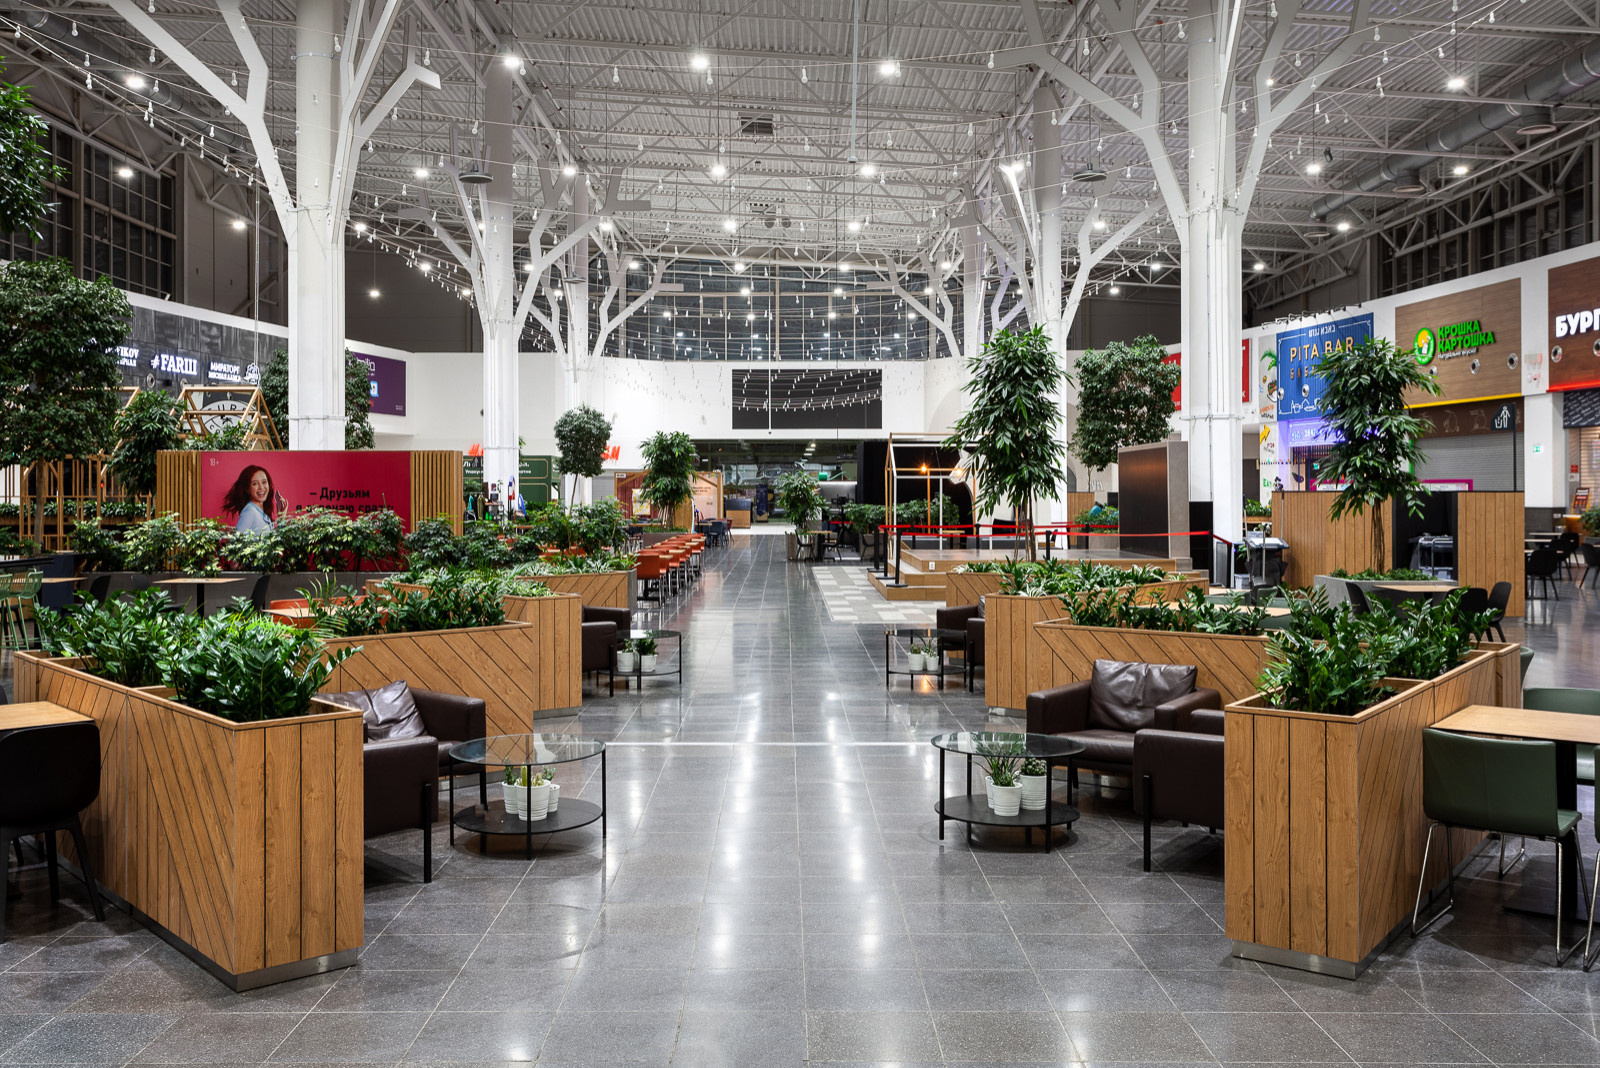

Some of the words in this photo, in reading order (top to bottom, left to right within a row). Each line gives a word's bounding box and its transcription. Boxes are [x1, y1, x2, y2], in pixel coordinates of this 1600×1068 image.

[1438, 320, 1480, 339] КРОШКА
[1290, 343, 1319, 362] PITA
[1324, 336, 1354, 356] BAR
[1438, 331, 1495, 352] КАРТОШКА
[210, 361, 240, 375] МИРАТОРГ
[320, 487, 370, 502] Друзьям
